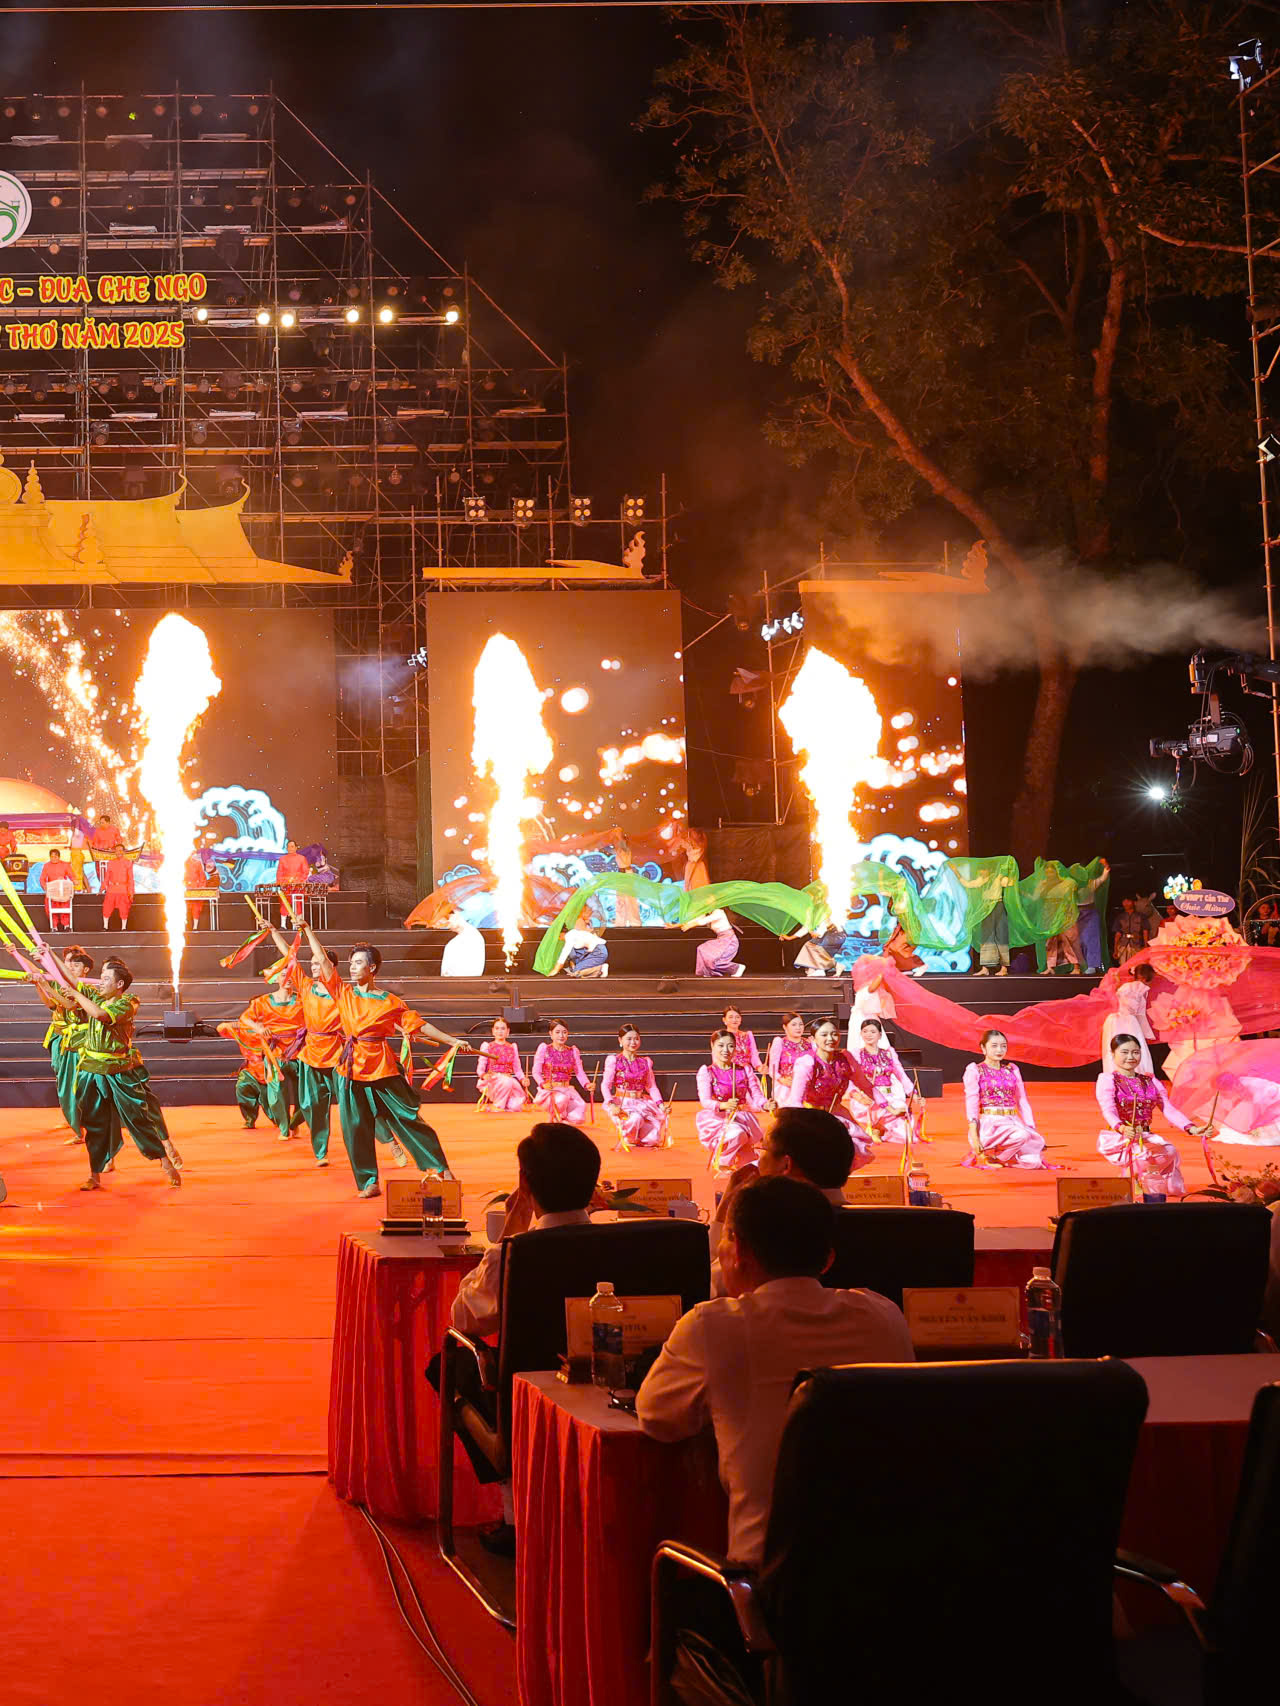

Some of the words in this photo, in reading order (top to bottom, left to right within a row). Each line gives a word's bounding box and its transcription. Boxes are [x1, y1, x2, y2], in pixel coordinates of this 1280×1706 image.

[39, 275, 92, 303] ĐUA
[98, 275, 150, 304] GHE
[154, 273, 207, 303] NGO
[6, 320, 57, 350] THƠ
[62, 317, 120, 349] NĂM
[124, 321, 185, 349] 2025
